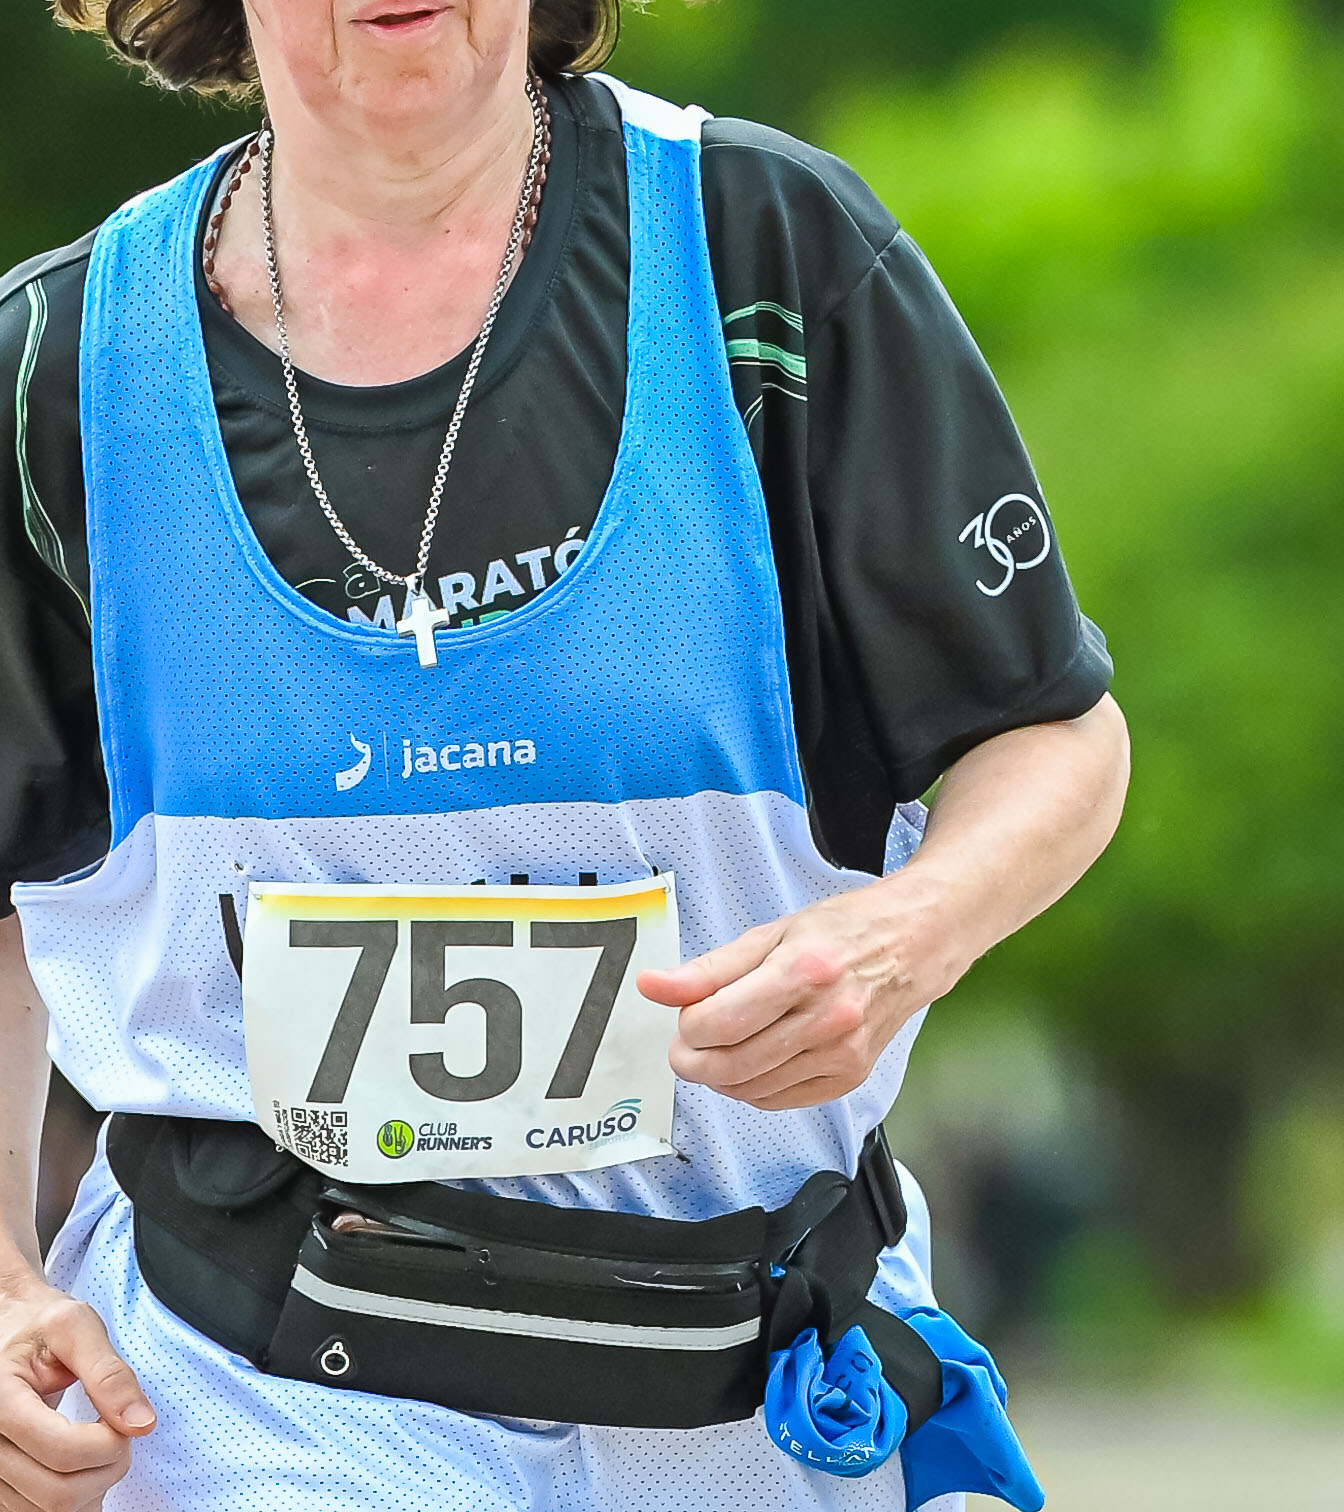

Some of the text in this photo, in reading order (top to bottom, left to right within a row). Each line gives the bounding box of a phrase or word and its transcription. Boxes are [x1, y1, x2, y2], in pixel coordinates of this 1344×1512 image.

[401, 738, 536, 779] jacana
[288, 916, 638, 1104] 757
[416, 1136, 493, 1152] RUNNER'S
[418, 1122, 458, 1137] CLUB
[525, 1112, 637, 1149] CARUSO
